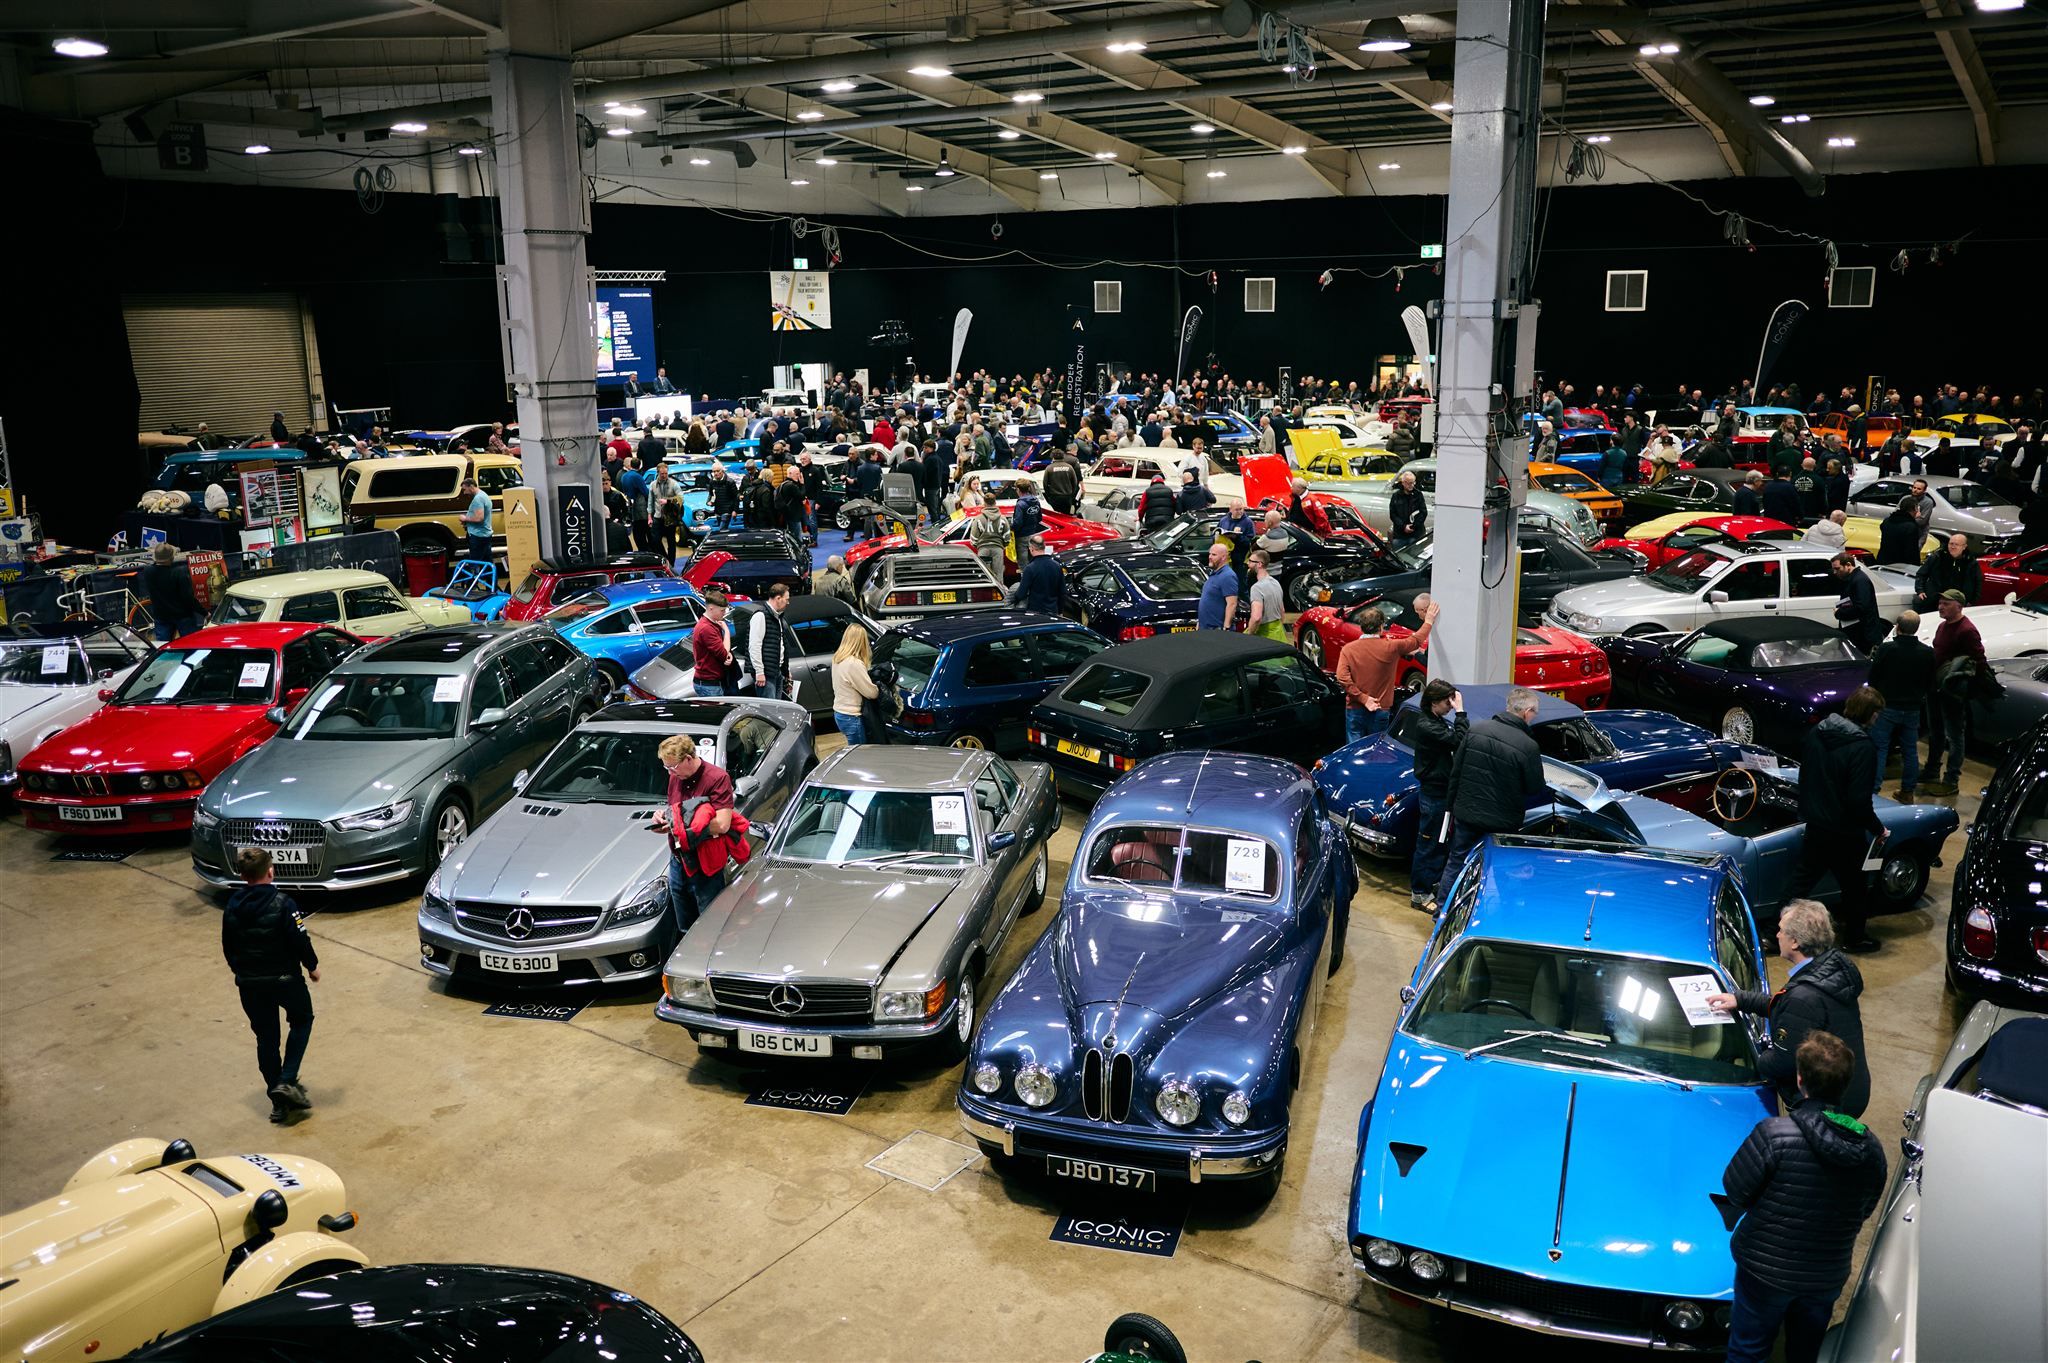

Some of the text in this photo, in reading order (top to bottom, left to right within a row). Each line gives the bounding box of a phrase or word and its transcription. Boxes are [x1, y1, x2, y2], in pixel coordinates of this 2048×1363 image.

[174, 146, 192, 164] B
[1184, 314, 1198, 342] ICONIC
[1772, 310, 1799, 344] ICONIC
[1073, 344, 1085, 416] REGISTRATION
[190, 565, 208, 576] FOOD
[47, 649, 65, 657] 744
[938, 800, 959, 809] 757
[63, 807, 117, 819] F960 DWW
[277, 850, 301, 862] SYA
[1234, 846, 1260, 858] 728
[485, 955, 551, 971] CEZ 6300
[1680, 981, 1712, 993] 732
[495, 1008, 564, 1018] AUCTIONEERS
[499, 1002, 572, 1015] ICONIC
[751, 1033, 818, 1052] 185 CMJ
[758, 1097, 838, 1110] AUCTIONEERS
[762, 1088, 844, 1105] ICONIC
[1056, 1160, 1145, 1188] JBO 137
[1067, 1219, 1166, 1243] ICONIC
[1064, 1231, 1162, 1250] AUCTIONEERS
